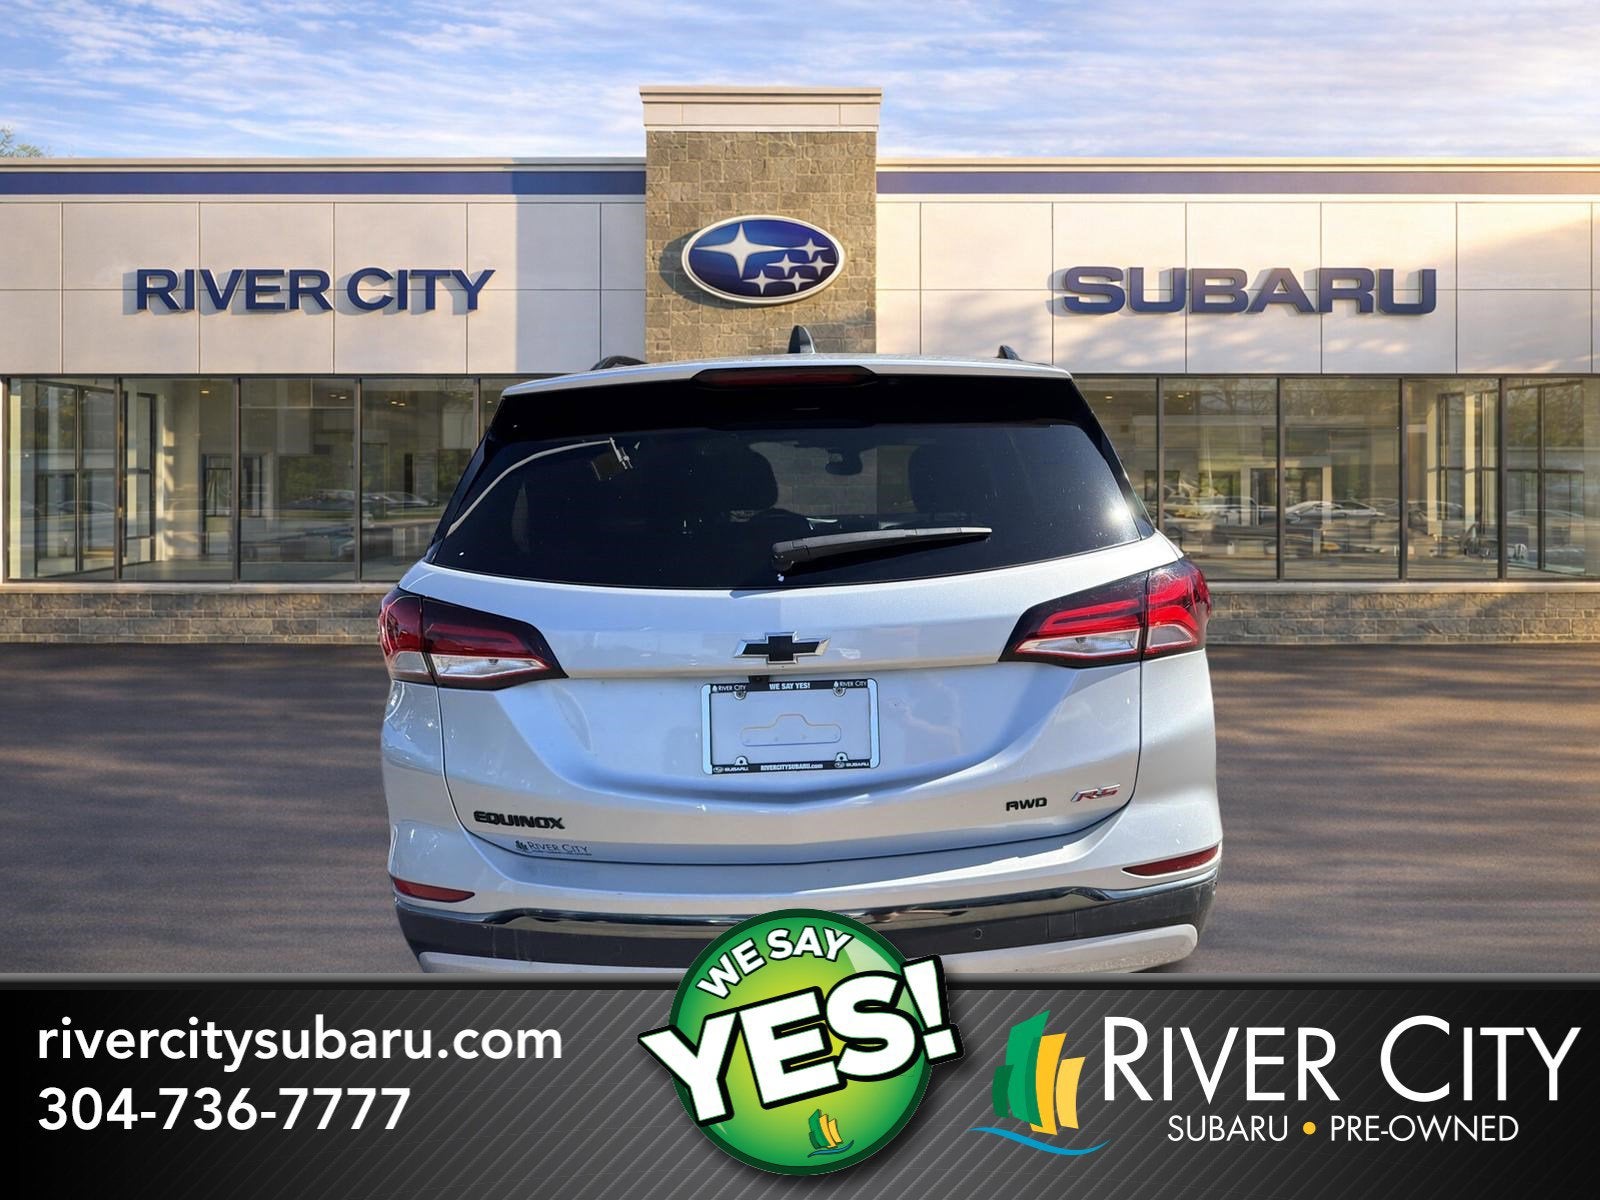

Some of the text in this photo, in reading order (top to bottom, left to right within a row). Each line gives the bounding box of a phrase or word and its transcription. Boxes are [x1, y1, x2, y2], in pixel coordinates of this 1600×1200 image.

[136, 266, 496, 311] RIVER CITY
[1063, 265, 1437, 315] SUBARU
[781, 682, 794, 690] SAY
[795, 681, 811, 689] YES!
[1006, 797, 1048, 812] AWD
[473, 810, 566, 830] EQUINOX
[527, 841, 560, 852] RIVER
[561, 843, 590, 854] CITY
